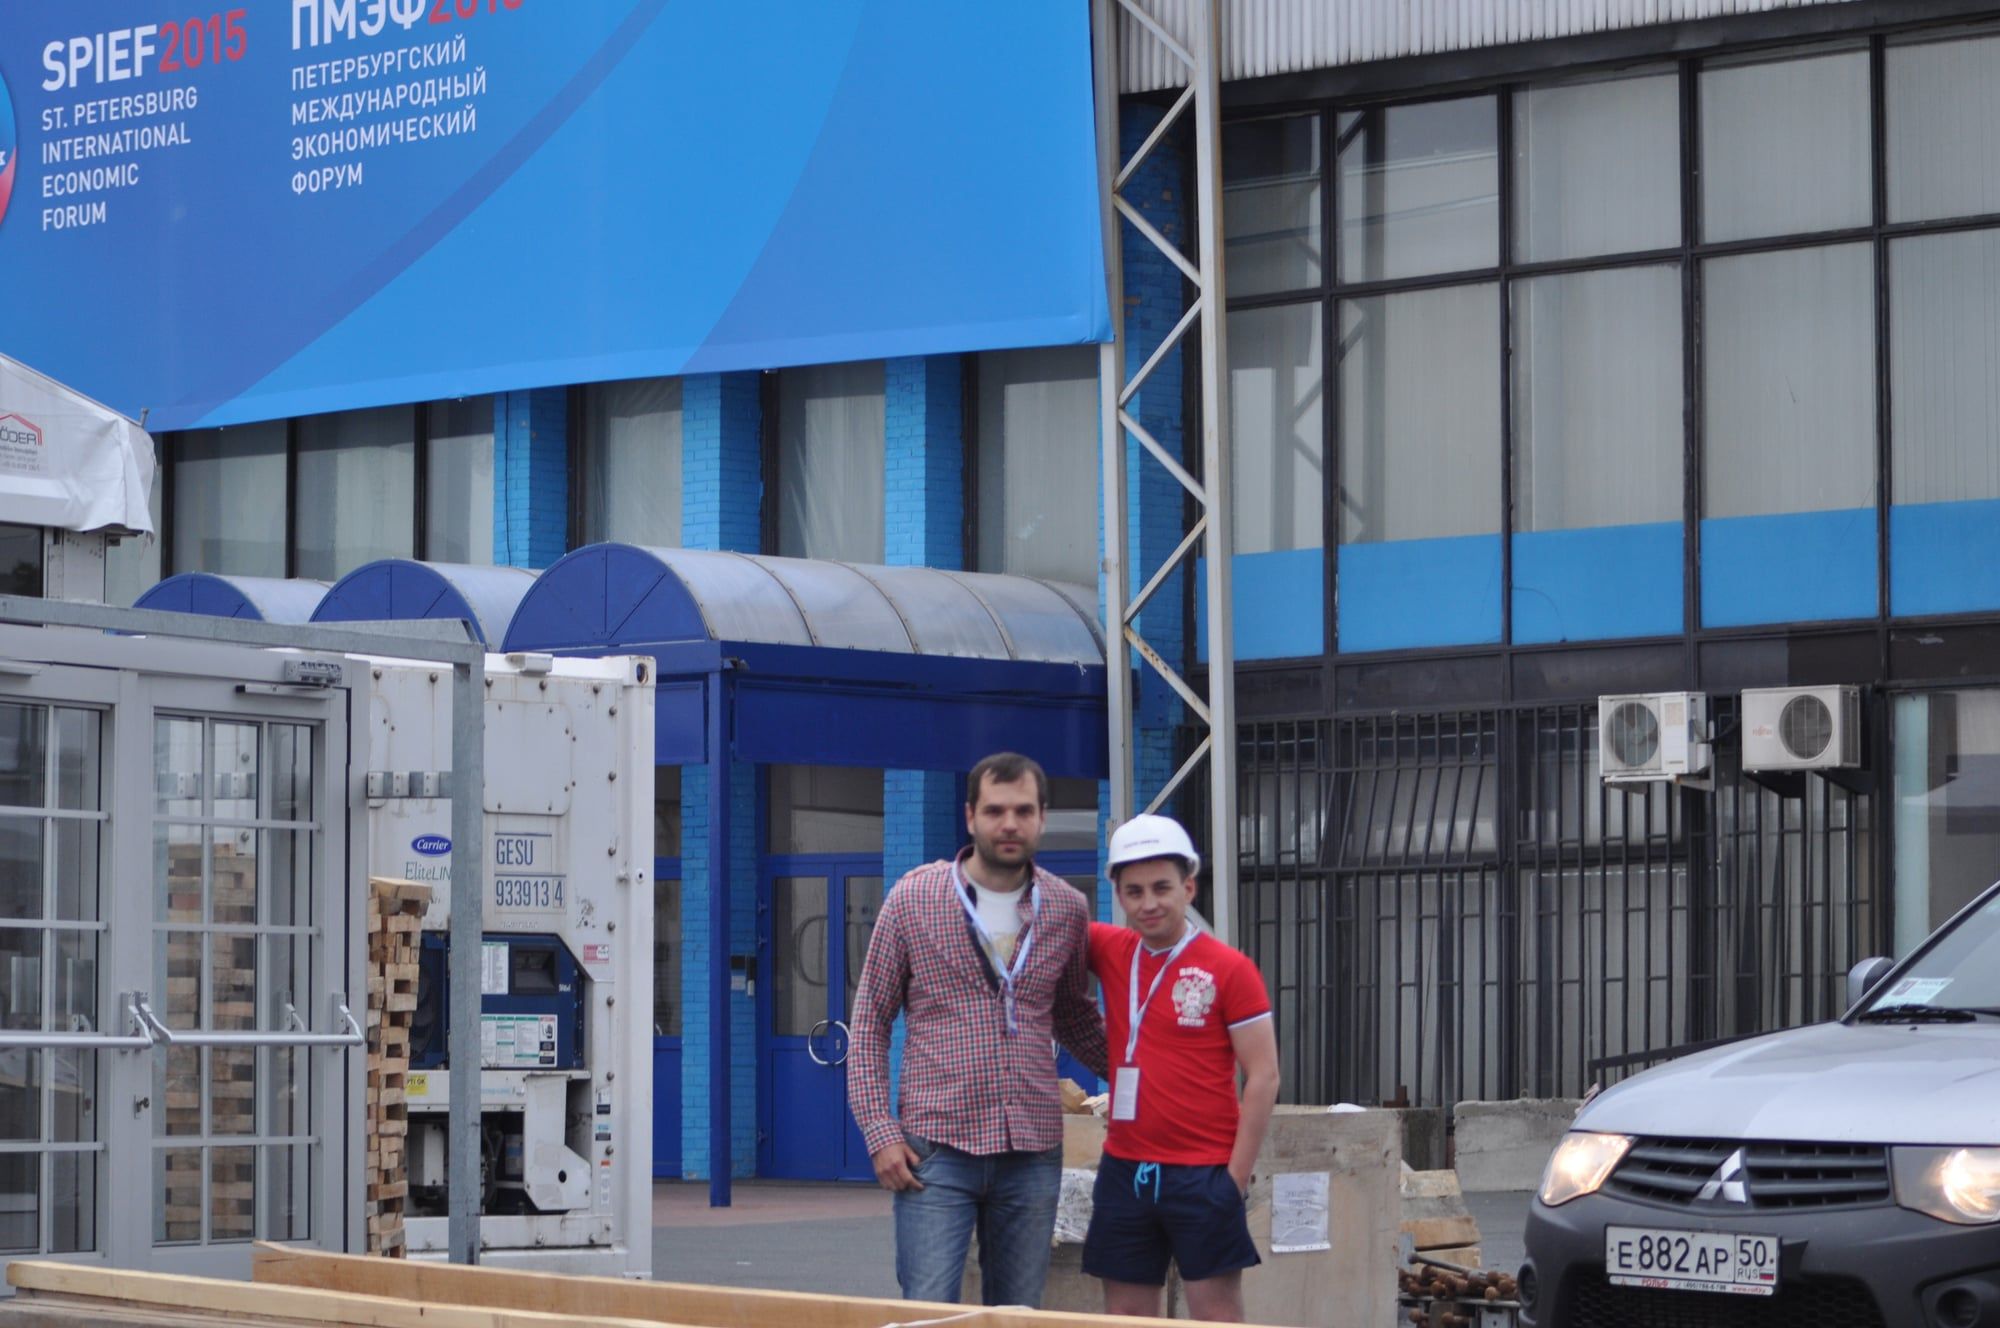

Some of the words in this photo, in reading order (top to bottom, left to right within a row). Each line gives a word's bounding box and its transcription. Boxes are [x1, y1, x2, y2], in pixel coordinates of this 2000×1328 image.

[292, 33, 466, 91] ПЕТЕРБУРГСКИЙ
[42, 107, 68, 131] ST.
[74, 86, 198, 126] PETERSBURG
[292, 65, 486, 126] МЕЖДУНАРОДНЫЙ
[42, 121, 191, 165] INTERNATIONAL
[292, 103, 476, 160] ЭКОНОМИЧЕСКИЙ
[42, 163, 139, 198] ECONOMIC
[291, 161, 363, 195] ФОРУМ
[42, 201, 107, 231] FORUM
[0, 425, 37, 446] ÖDER
[416, 838, 449, 851] Carrier
[495, 838, 534, 866] GESU
[405, 860, 452, 881] EliteLIN
[495, 879, 550, 907] 933913
[554, 880, 563, 907] 4
[1738, 1239, 1767, 1268] 50
[1737, 1267, 1759, 1280] RUS
